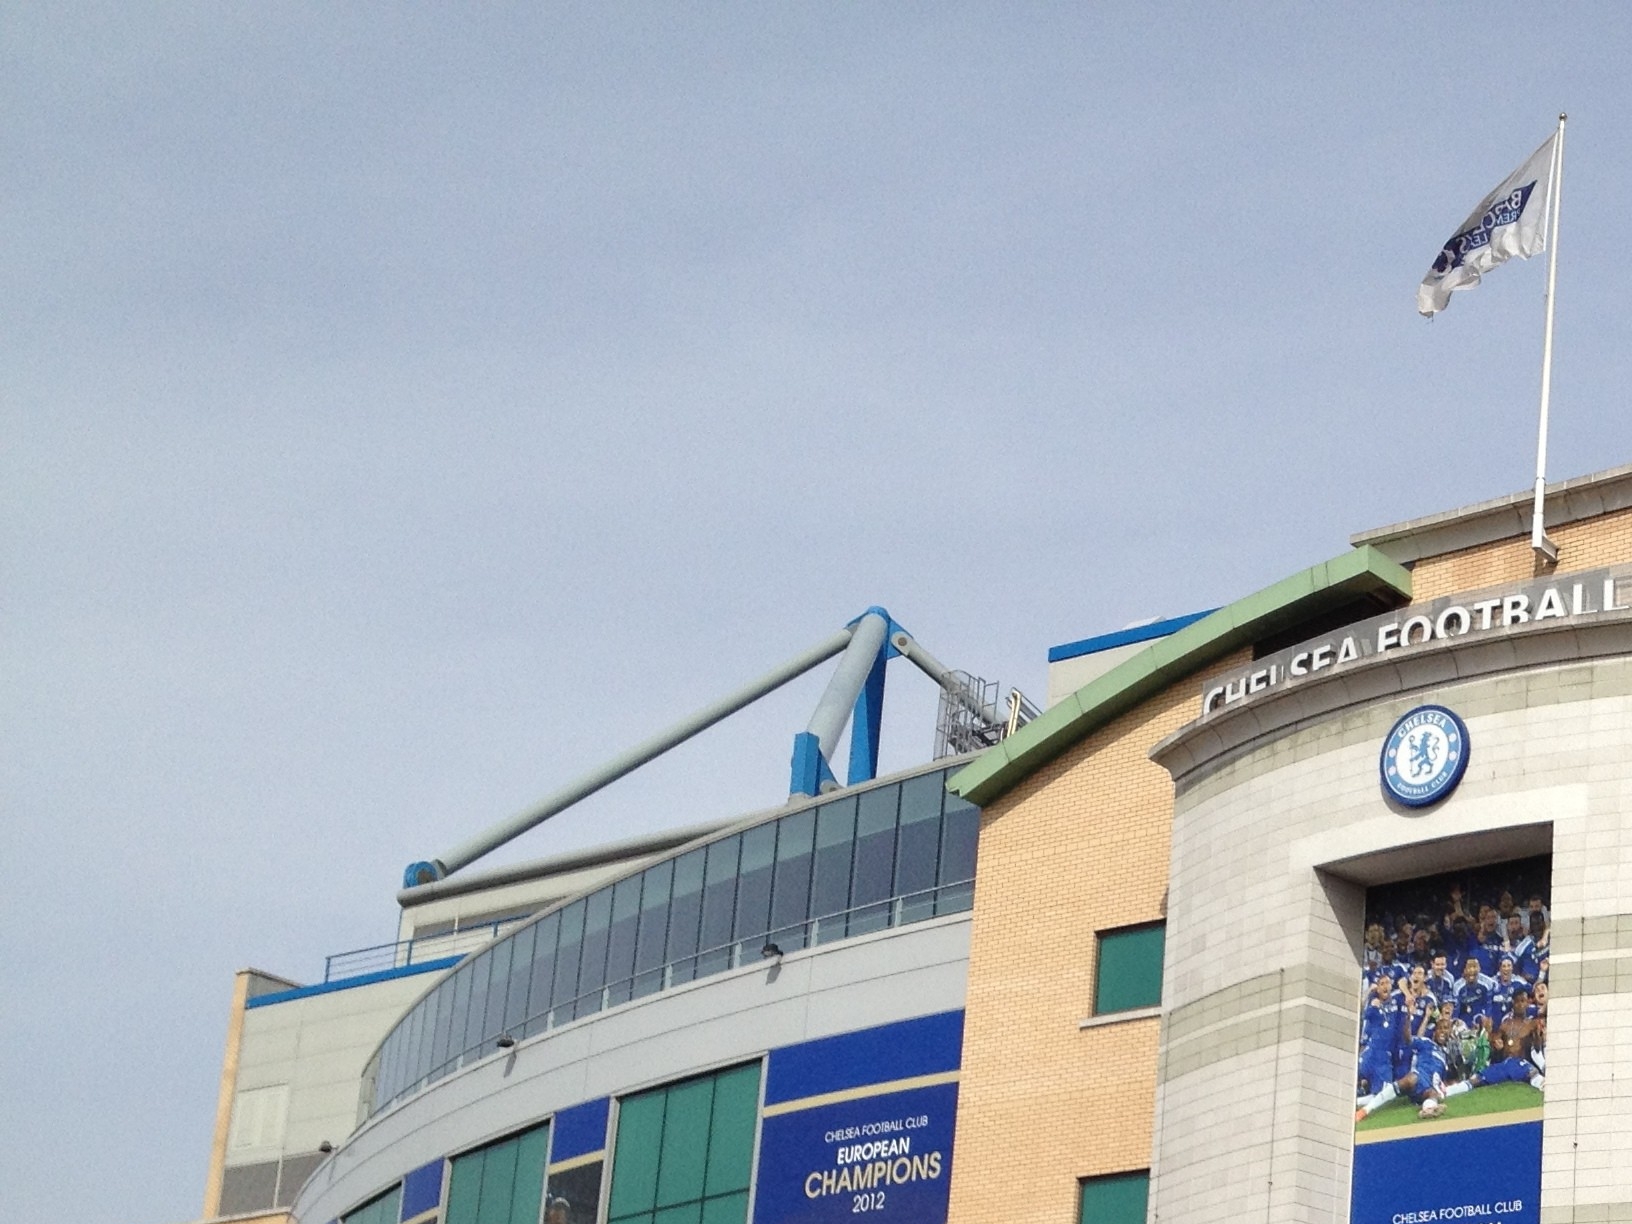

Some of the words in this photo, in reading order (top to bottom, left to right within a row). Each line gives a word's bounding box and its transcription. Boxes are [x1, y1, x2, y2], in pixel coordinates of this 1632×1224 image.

[1377, 578, 1631, 652] FOOTBALL
[1398, 713, 1447, 738] CHELSEA
[824, 1125, 860, 1143] CHELSEA
[861, 1120, 904, 1137] FOOTBALL
[905, 1115, 928, 1130] CLUB
[837, 1136, 910, 1165] EUROPEAN
[804, 1151, 942, 1199] CHAMPIONS
[852, 1191, 886, 1213] 2012
[1439, 1203, 1492, 1220] FOOTBALL
[1494, 1199, 1523, 1213] CLUB
